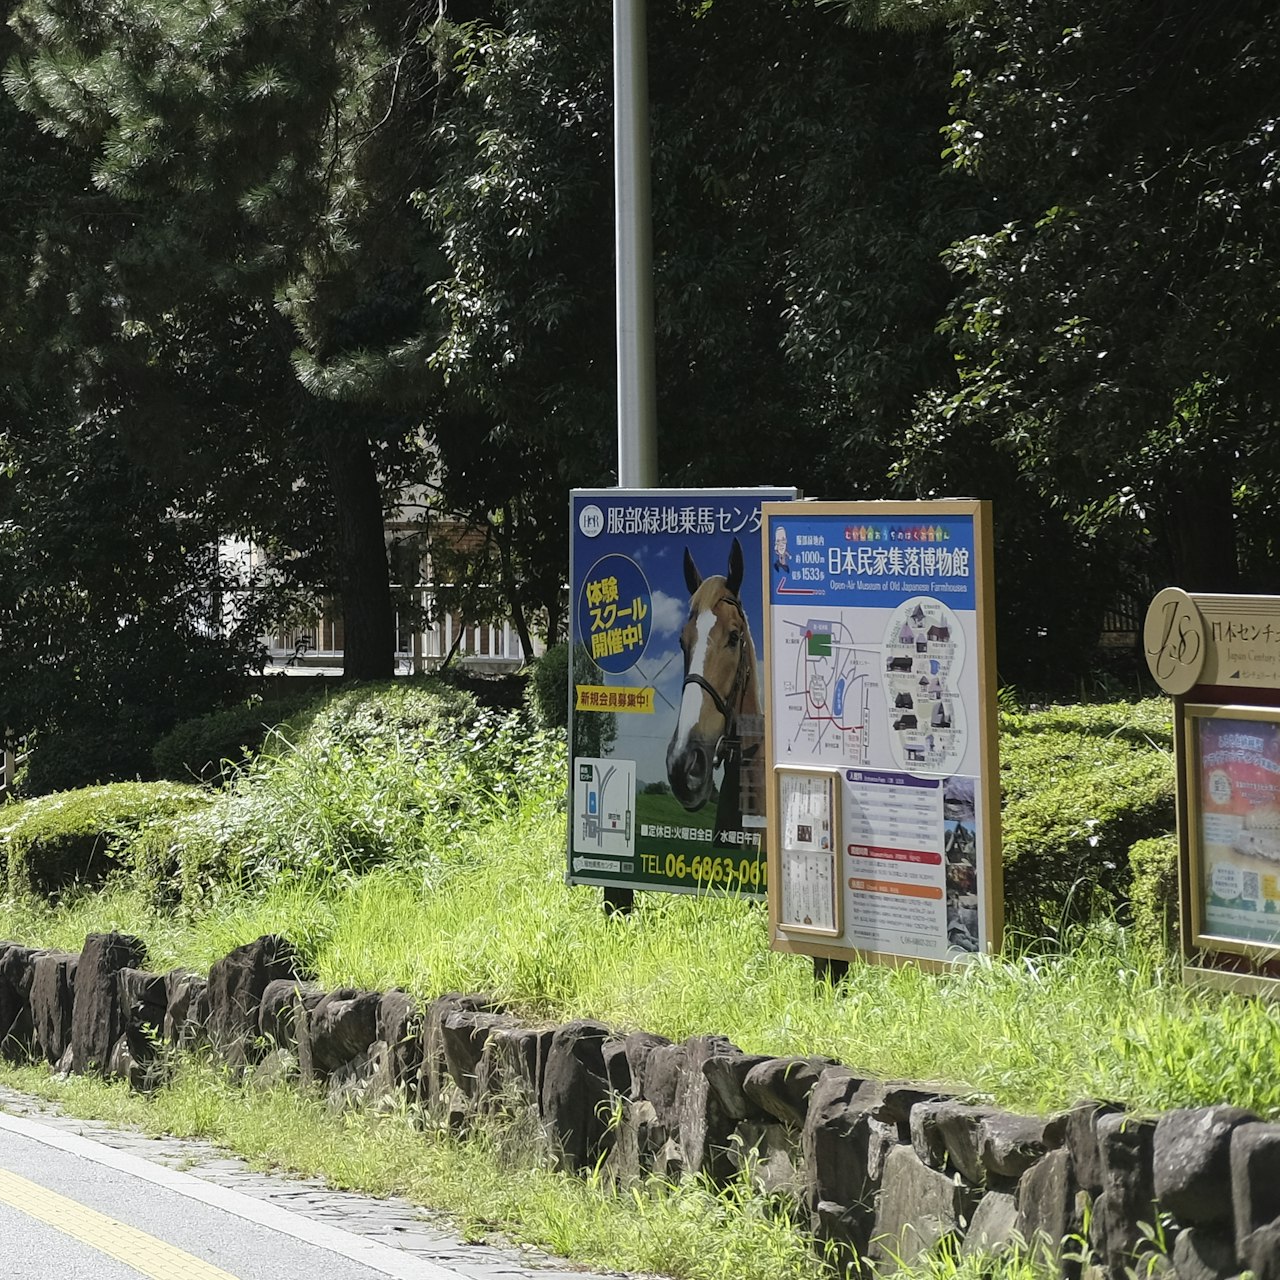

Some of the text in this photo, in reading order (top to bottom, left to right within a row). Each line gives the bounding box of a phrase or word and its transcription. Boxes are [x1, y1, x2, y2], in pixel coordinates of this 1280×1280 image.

[606, 506, 762, 534] 服部緑地乗馬センタ
[828, 546, 970, 577] 日本民家集落博物館
[586, 576, 619, 608] 体験
[829, 579, 968, 593] Open-Air Museum of Old Japanese Farmhouses
[589, 596, 648, 632] スクール
[590, 623, 644, 660] 開催中!
[580, 691, 649, 708] 新規会員募集中!
